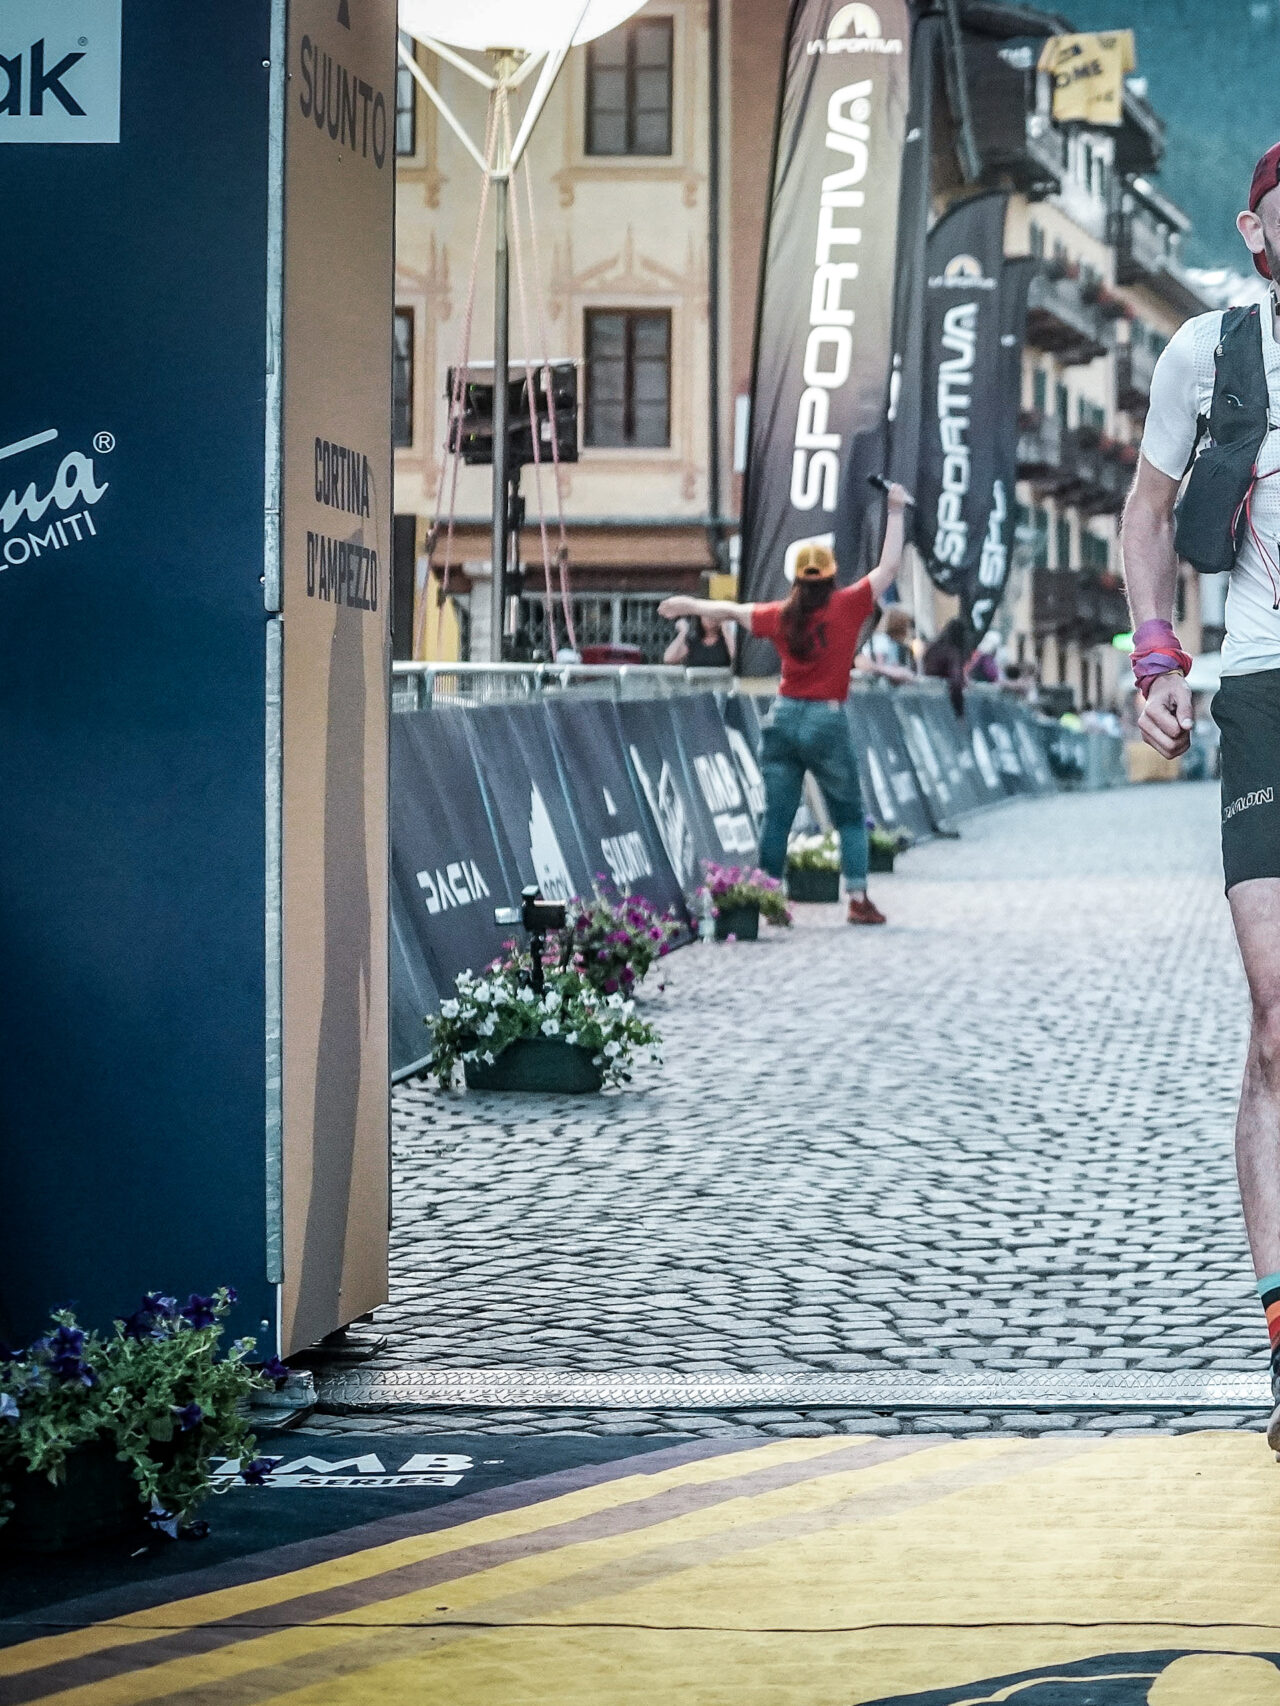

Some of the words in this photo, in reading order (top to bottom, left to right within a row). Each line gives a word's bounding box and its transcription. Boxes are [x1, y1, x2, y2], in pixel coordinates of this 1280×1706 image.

[300, 34, 387, 170] SUUNTO
[789, 78, 874, 513] SPORTIVA
[933, 302, 979, 568] SPORTIVA
[314, 437, 370, 519] CORTINA
[307, 530, 378, 612] D'AMPEZZO
[207, 1453, 475, 1475] TMB
[296, 1474, 447, 1487] SERIES
